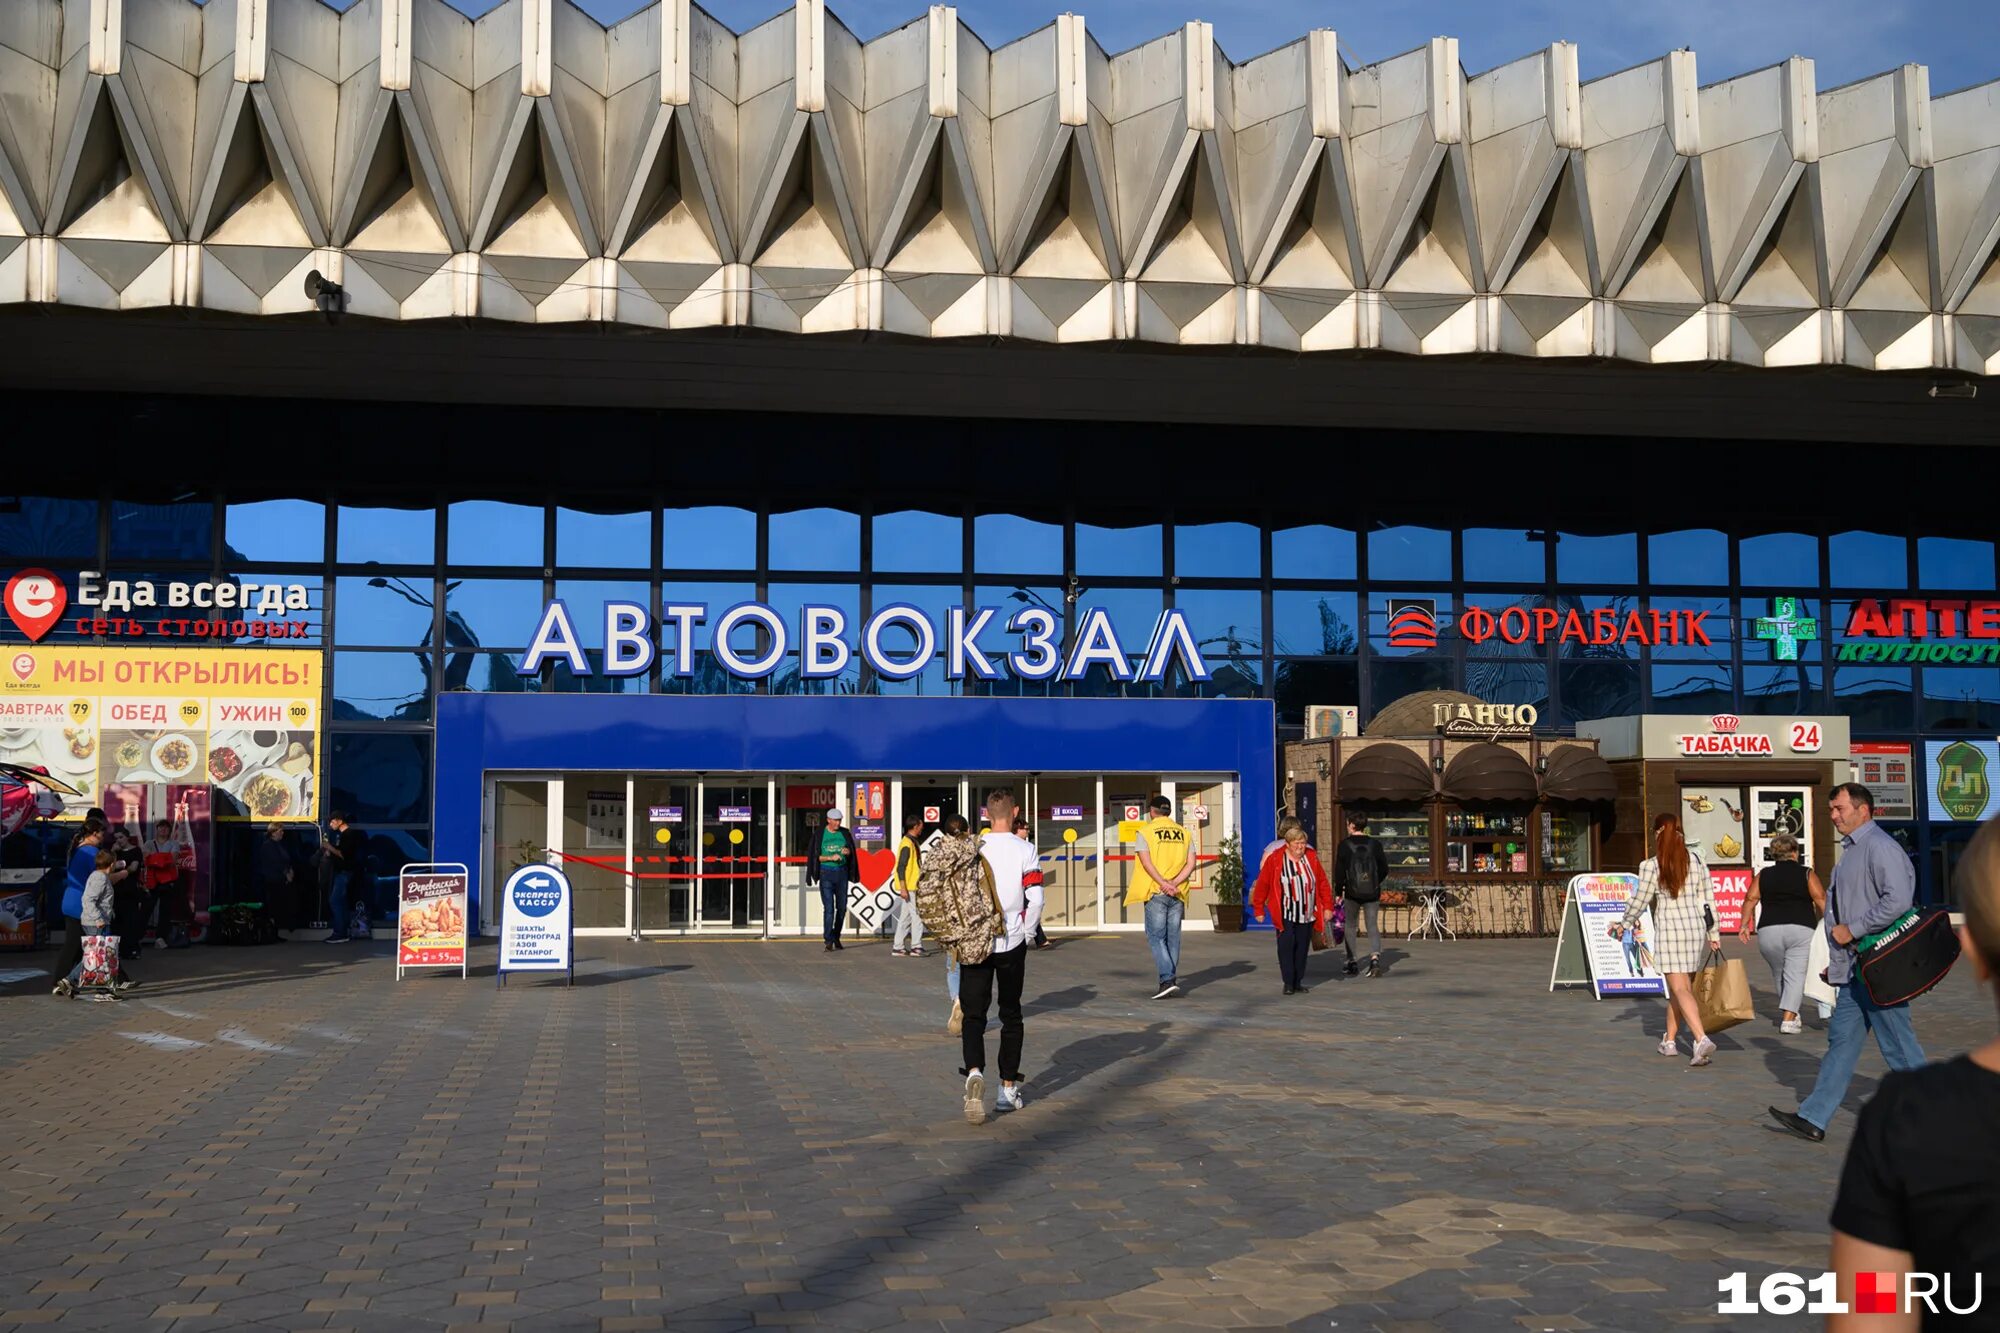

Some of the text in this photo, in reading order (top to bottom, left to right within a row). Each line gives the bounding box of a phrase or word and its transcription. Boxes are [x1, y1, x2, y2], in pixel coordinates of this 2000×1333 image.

[78, 571, 309, 615] Еда всегда
[1459, 606, 1713, 646] ФОРАБАНК
[1845, 598, 2000, 638] АПТЕ
[76, 617, 309, 638] сеть столовых
[1757, 621, 1815, 635] АПТЕКА
[516, 599, 1212, 682] АВТОВОКЗАЛ
[53, 659, 309, 685] МЫ ОТКРЫЛИСЬ!
[73, 703, 89, 715] 79
[111, 704, 167, 723] ОБЕД
[182, 706, 199, 715] 150
[220, 705, 281, 722] УЖИН
[290, 707, 307, 716] 100
[1432, 703, 1538, 726] ПАНЧО
[1446, 719, 1531, 741] Кондитерская
[1793, 725, 1819, 747] 24
[1682, 736, 1771, 752] ТАБАЧКА
[1061, 808, 1079, 816] ВХОД
[1155, 830, 1184, 841] TAXI
[1586, 882, 1634, 892] СМЕШНЫЕ
[1598, 891, 1626, 901] ЦЕНЫ
[438, 952, 449, 960] 55
